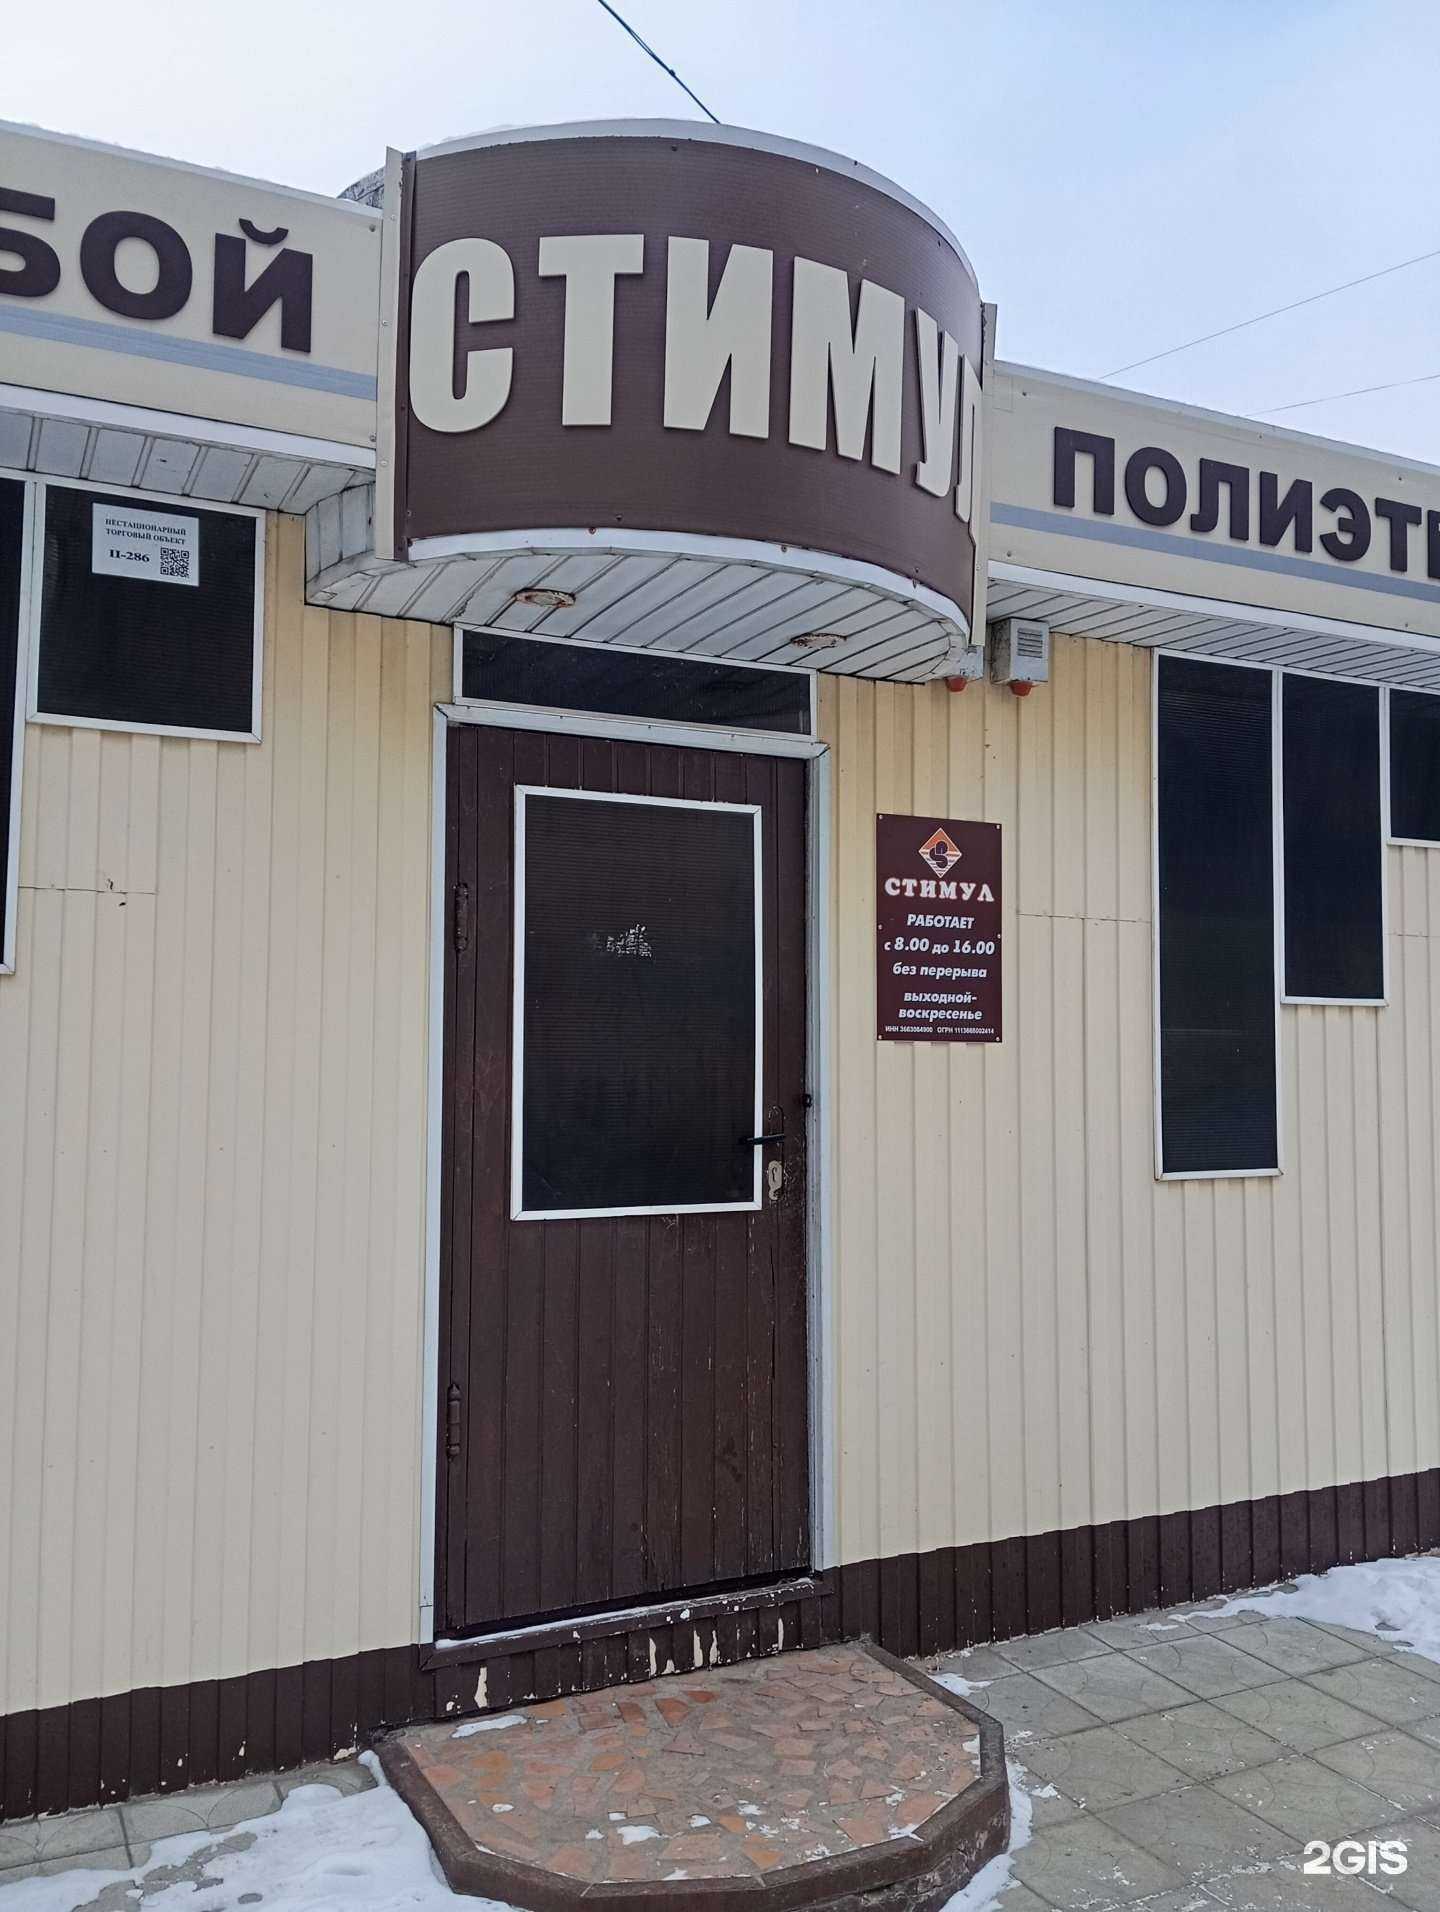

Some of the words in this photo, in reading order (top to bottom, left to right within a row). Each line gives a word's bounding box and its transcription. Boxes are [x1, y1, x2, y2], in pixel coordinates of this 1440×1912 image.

[1054, 427, 1440, 579] ПОЛИЭТ
[106, 528, 151, 540] ТОРГОВЫЙ
[153, 534, 185, 545] ОБЪЕКТ
[884, 877, 995, 902] СТИМУЛ
[906, 913, 975, 929] РАБОТАЕТ
[884, 941, 891, 951] с
[894, 937, 930, 952] 8.00
[931, 944, 950, 955] до
[953, 940, 995, 955] 16.00
[893, 962, 917, 975] без
[920, 966, 988, 980] перерыва
[903, 992, 977, 1004] выходной-
[898, 1008, 983, 1022] воскресенье
